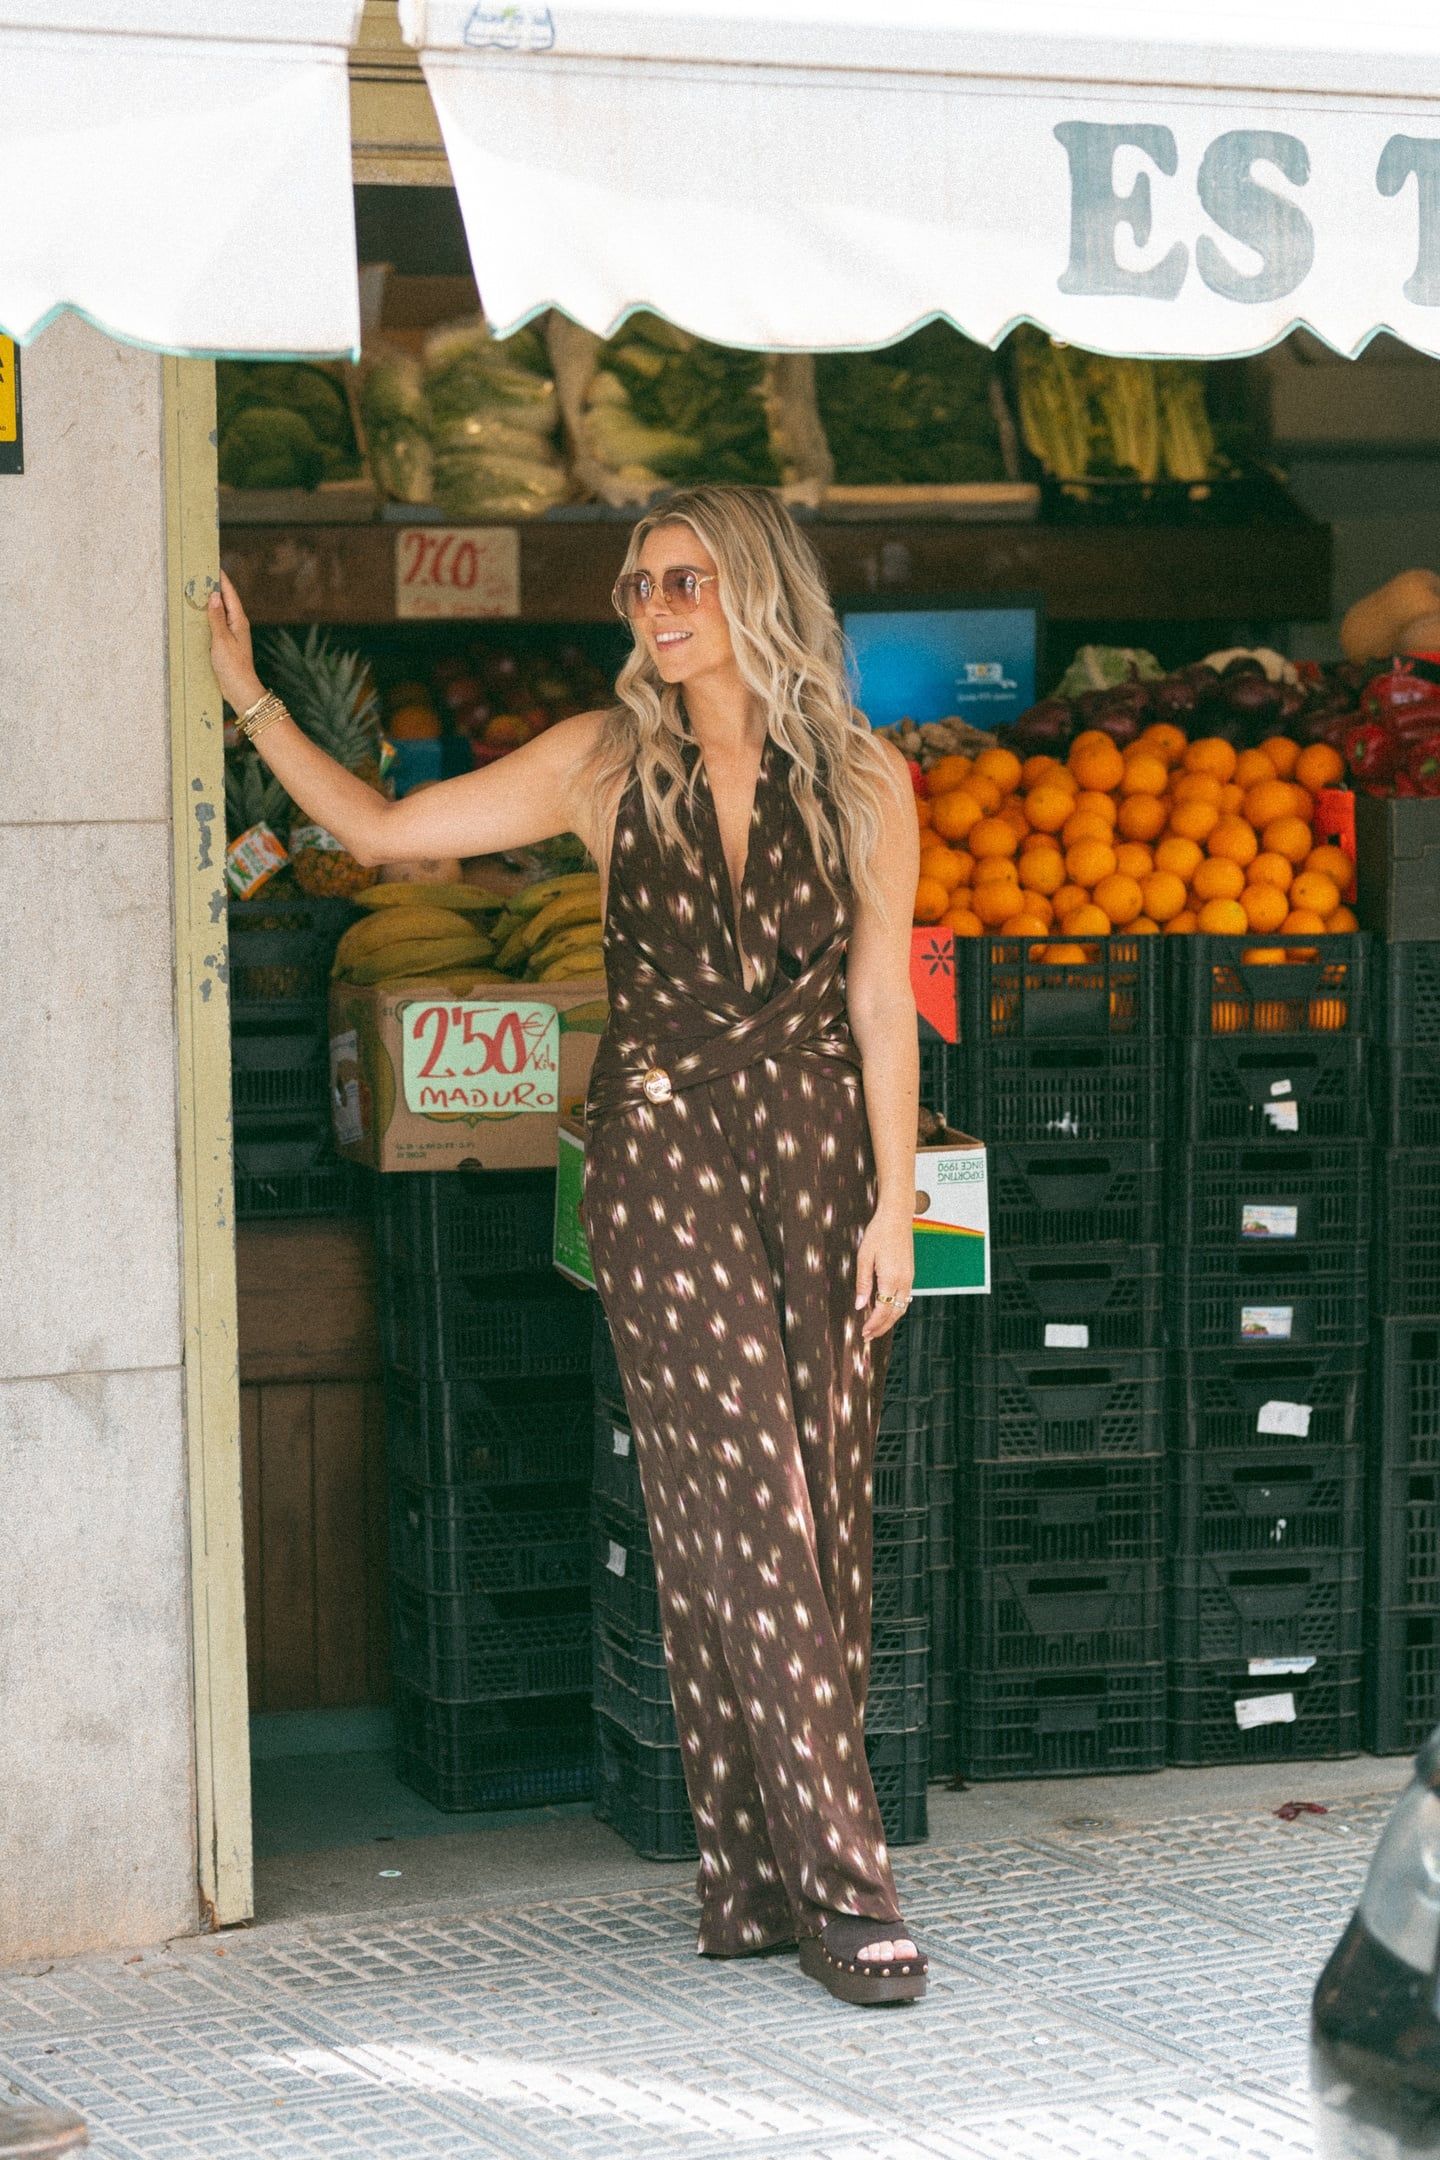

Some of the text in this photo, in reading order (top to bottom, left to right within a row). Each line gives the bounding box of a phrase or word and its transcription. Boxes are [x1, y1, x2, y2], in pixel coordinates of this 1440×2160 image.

[420, 1083, 554, 1109] MADURO
[937, 1162, 958, 1172] 1990
[937, 1170, 984, 1182] EXPORTING
